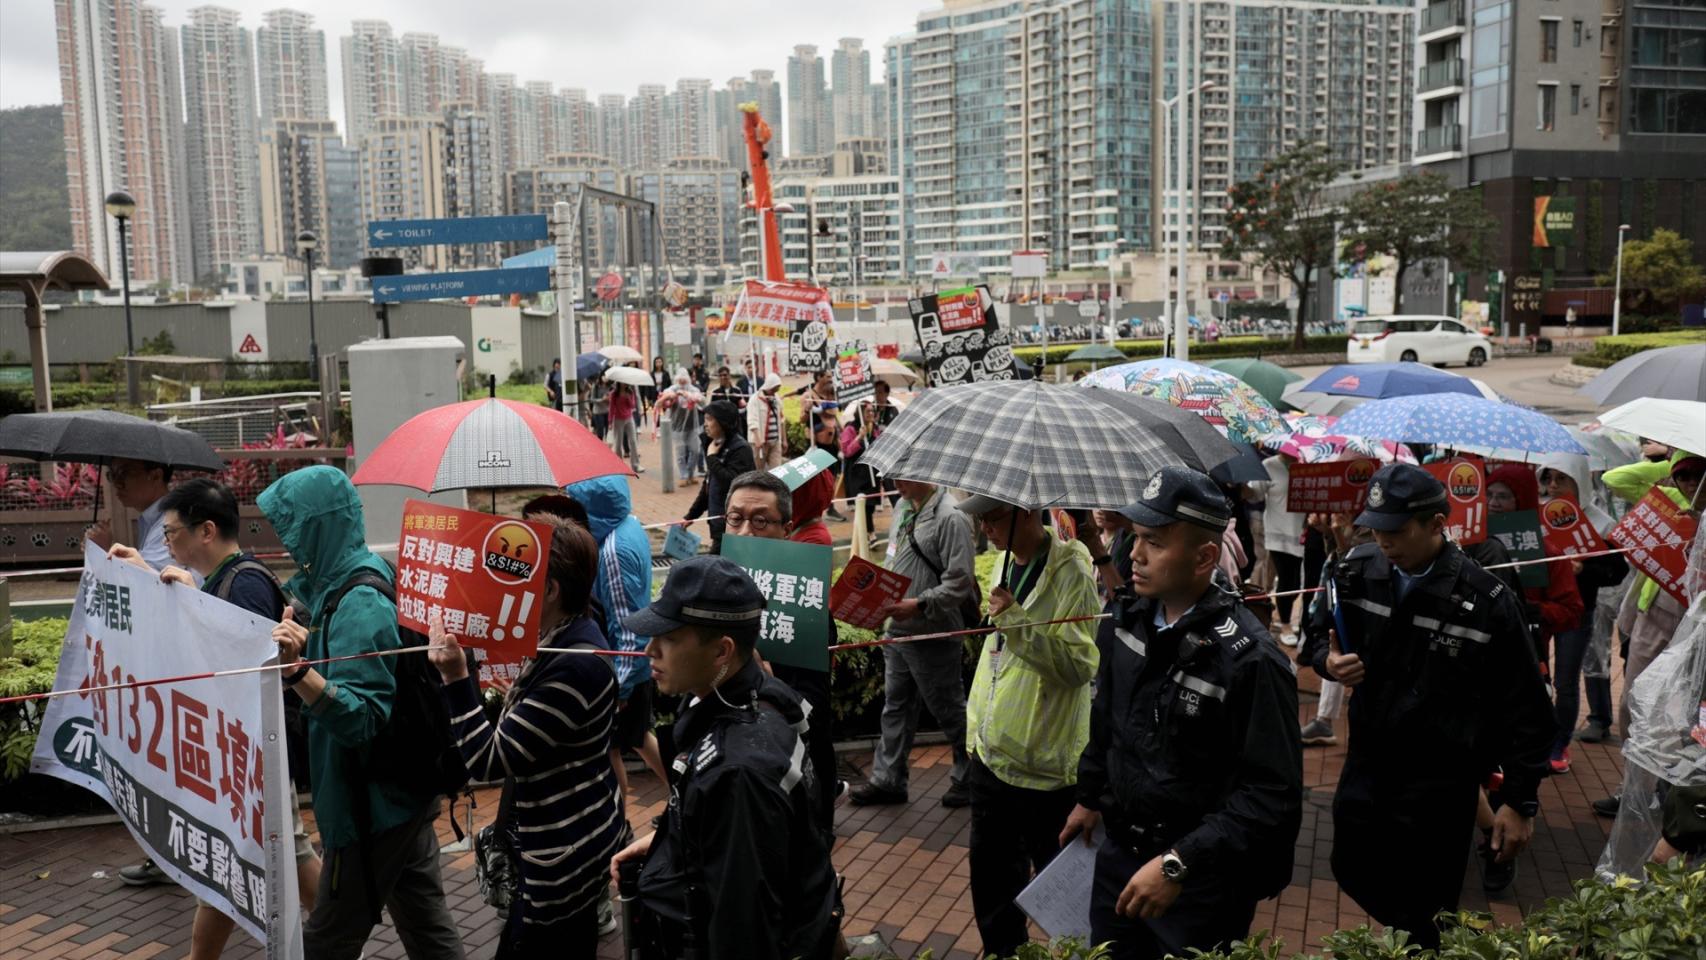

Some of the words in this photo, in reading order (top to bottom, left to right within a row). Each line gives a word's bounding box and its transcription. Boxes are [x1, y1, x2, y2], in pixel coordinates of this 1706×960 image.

[399, 228, 432, 238] TOILET
[401, 282, 429, 293] VIEWING
[431, 280, 464, 291] PLATFORM
[945, 364, 967, 379] PLANT
[989, 353, 1013, 370] PLANT
[478, 460, 511, 468] INCOME
[404, 514, 459, 531] 將軍澳居民
[402, 534, 476, 574] 反對興建
[487, 552, 532, 579] &$!#%
[400, 564, 449, 600] 水泥廠
[740, 566, 824, 610] 將軍澳
[399, 592, 491, 640] 垃圾處理廠
[492, 590, 536, 642] !!
